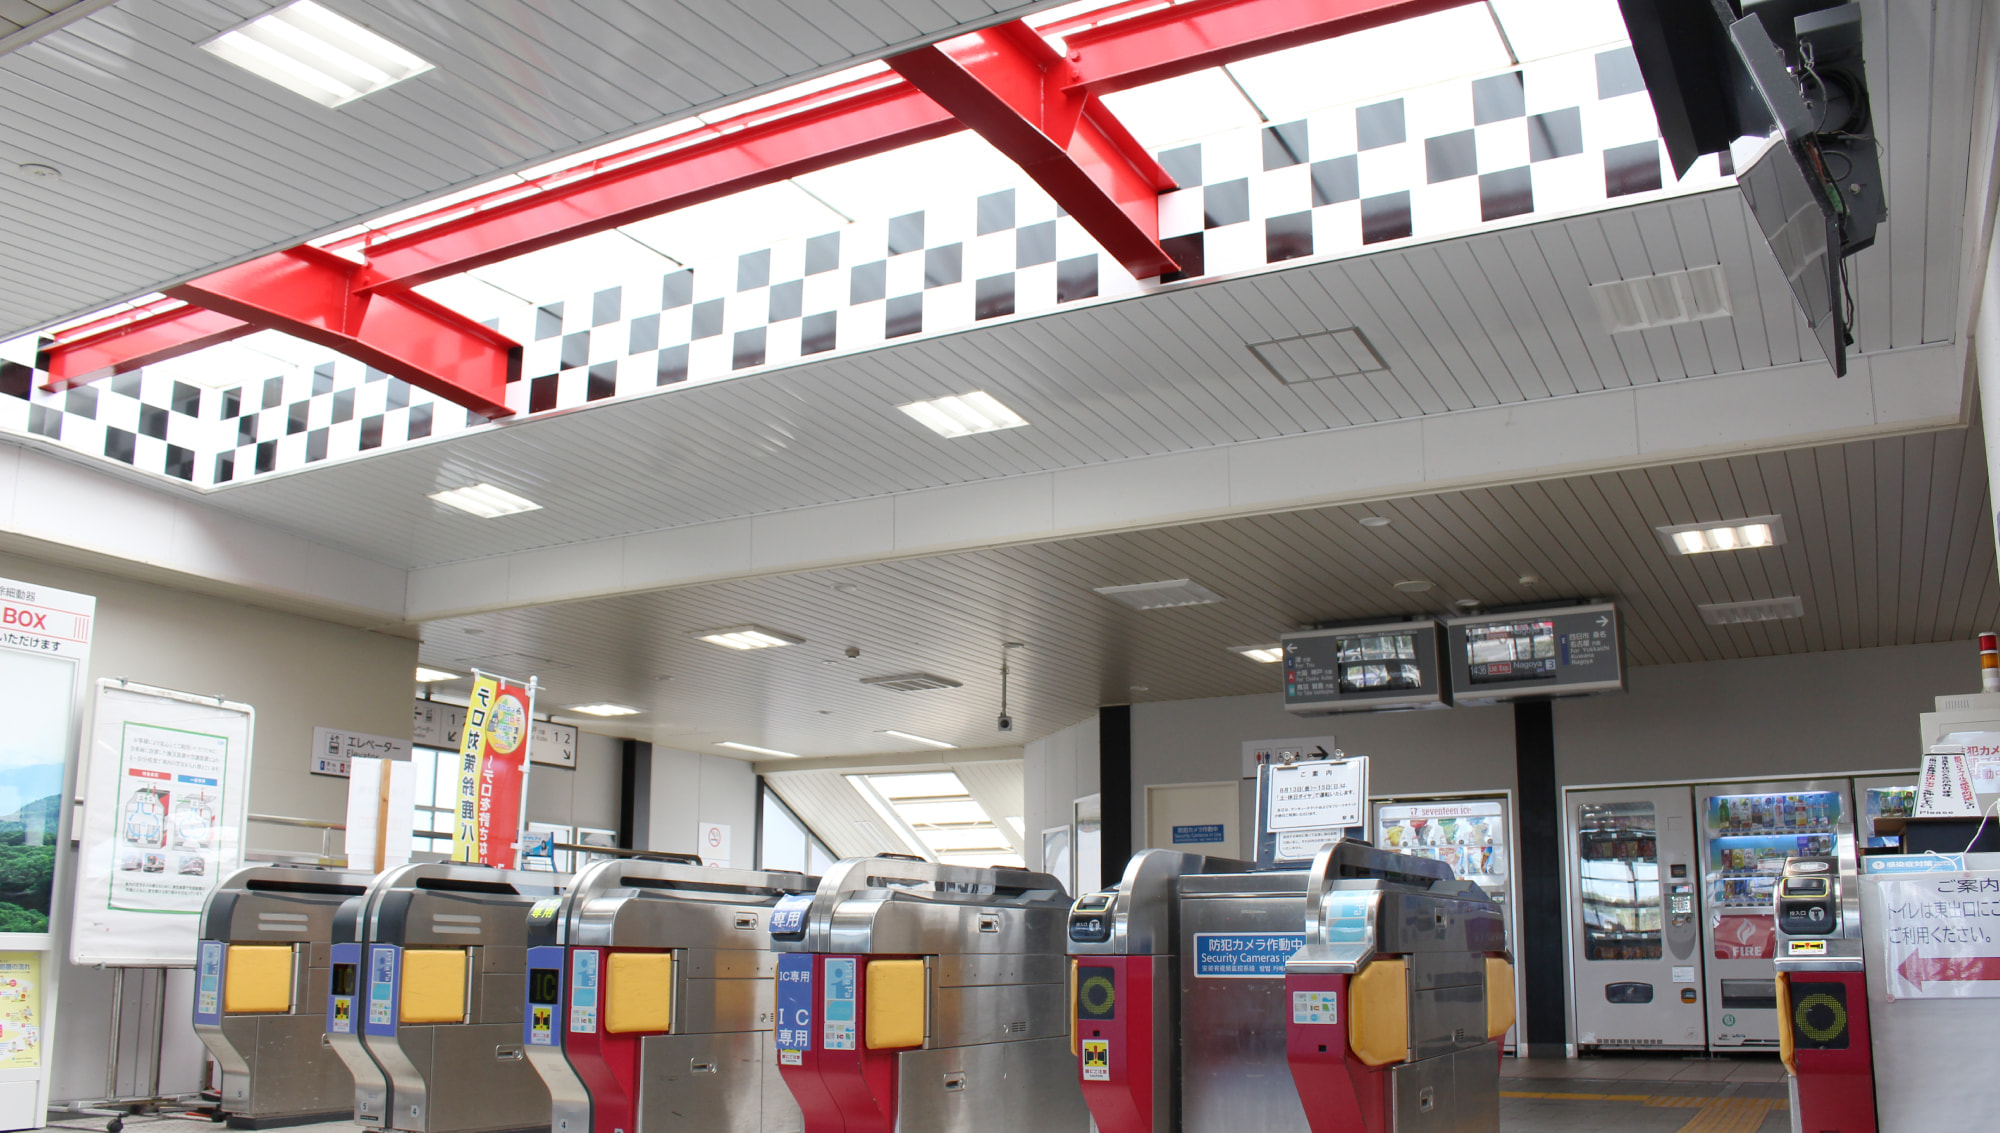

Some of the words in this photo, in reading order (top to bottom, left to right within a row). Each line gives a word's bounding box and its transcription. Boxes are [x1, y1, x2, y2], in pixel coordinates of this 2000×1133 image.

[3, 607, 47, 630] BOX
[1513, 660, 1543, 669] Nagoya
[347, 736, 401, 752] エレベーター
[553, 731, 558, 742] 1
[564, 733, 571, 745] 2
[1422, 807, 1459, 816] seventeen
[1460, 805, 1472, 814] ice
[1937, 877, 2000, 893] ご案内
[772, 911, 801, 928] 専用
[1889, 926, 1991, 945] ご利用ください。
[1208, 938, 1303, 951] 防犯カメラ作動中
[1732, 946, 1762, 957] FIRE
[1201, 952, 1238, 965] Security
[1240, 953, 1280, 963] Cameras
[780, 971, 810, 983] IC専用
[535, 974, 556, 1001] IC
[778, 1028, 808, 1047] 専用
[362, 1102, 367, 1110] 5
[412, 1107, 417, 1116] 4
[561, 1120, 566, 1128] 4
